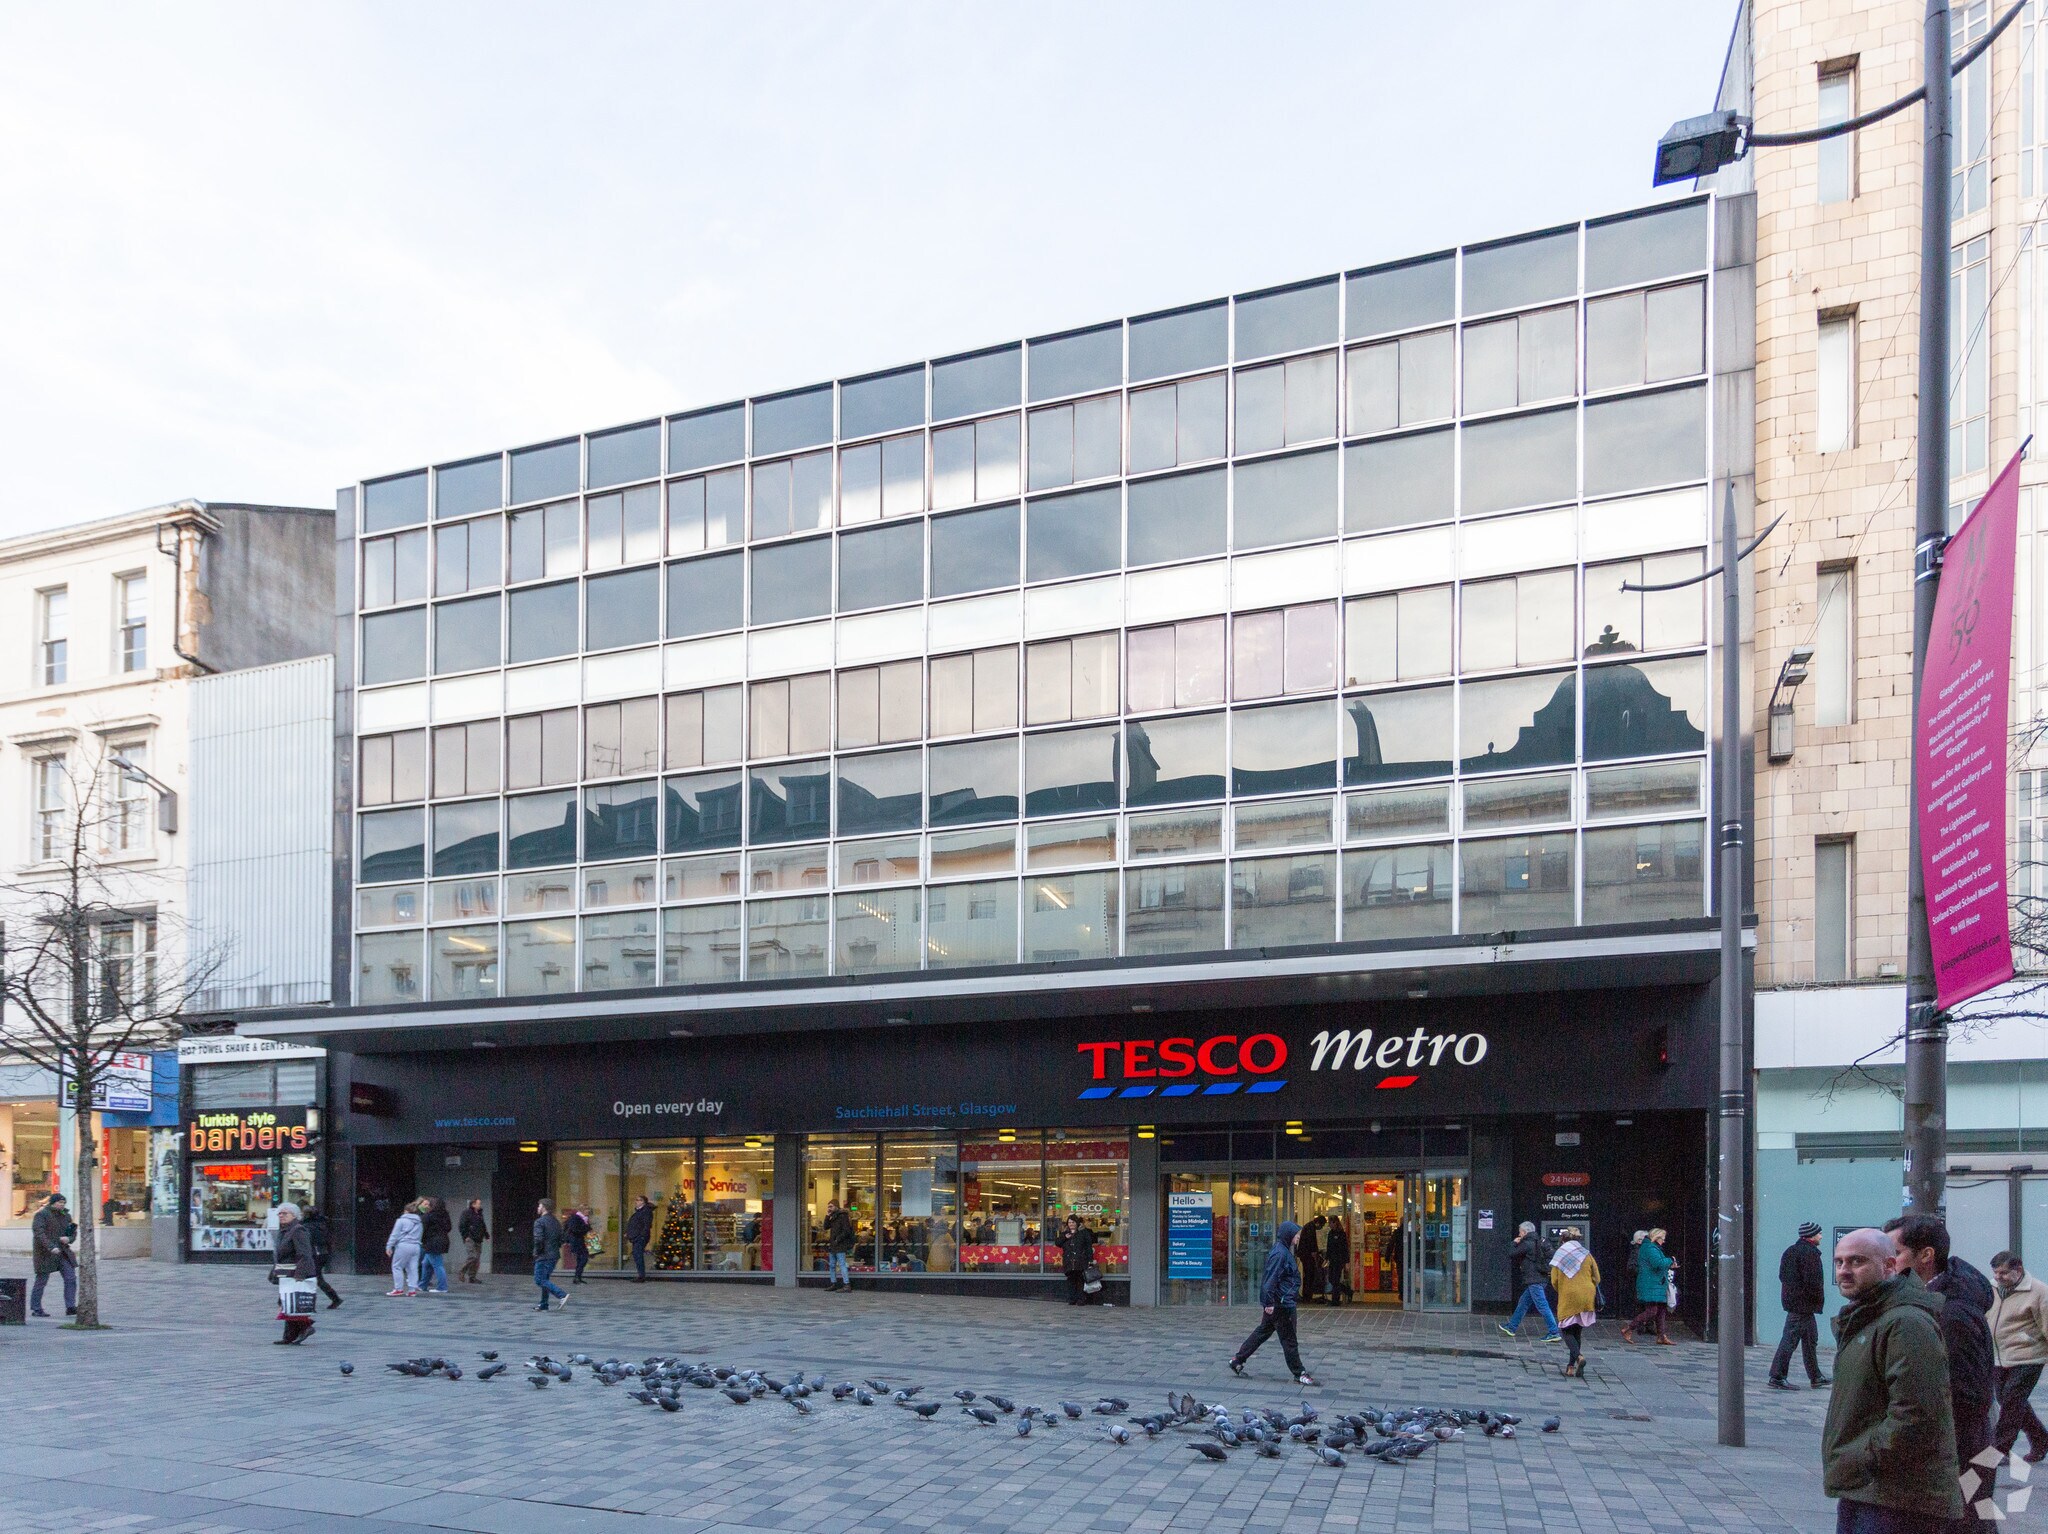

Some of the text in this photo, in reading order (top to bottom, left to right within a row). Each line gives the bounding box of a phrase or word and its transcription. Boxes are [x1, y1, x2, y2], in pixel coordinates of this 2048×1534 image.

[1939, 659, 1982, 699] Glasgow Art Club
[1928, 717, 1937, 728] The
[1937, 699, 1958, 720] Glasgow
[1958, 682, 1977, 703] School
[1985, 669, 1994, 683] Art
[1929, 720, 1955, 747] Mackintosh
[1956, 708, 1973, 724] House
[1980, 694, 1992, 706] The
[1955, 714, 1982, 739] University
[1946, 738, 1968, 758] Glasgow
[1931, 774, 1945, 790] House
[1945, 768, 1954, 779] For
[1962, 756, 1971, 768] Art
[1971, 745, 1986, 761] Lover
[1953, 783, 1961, 795] Art
[1961, 770, 1981, 788] Gallery
[1981, 760, 1992, 775] and
[1946, 793, 1968, 813] Museum
[1940, 808, 1977, 837] The Lighthouse
[1931, 842, 1956, 864] Mackintosh
[1962, 832, 1972, 843] The
[1971, 820, 1990, 837] Willow
[1942, 848, 1979, 878] Mackintosh Club
[1934, 863, 1992, 903] Mackintosh Queen's Cross
[1932, 881, 1999, 925] Scotland Street School Museum
[1950, 926, 1958, 935] The
[1965, 913, 1980, 926] House
[198, 1044, 223, 1054] TOWEL
[225, 1043, 250, 1052] SHAVE
[252, 1043, 258, 1051] &
[261, 1040, 285, 1051] GENTS
[1077, 1027, 1489, 1080] TESCO Metro
[613, 1098, 724, 1118] Open every day
[835, 1102, 1017, 1119] Sauchiehall Street, Glasgow
[199, 1112, 276, 1128] Turkish style
[434, 1116, 516, 1128] www.tesco.com
[190, 1120, 307, 1151] barbers
[709, 1176, 747, 1194] Services
[1563, 1175, 1581, 1183] hour
[1068, 1204, 1103, 1212] TESCO
[1172, 1196, 1196, 1205] Hello
[1542, 1202, 1589, 1210] withdrawals
[1547, 1194, 1585, 1202] Free Cash
